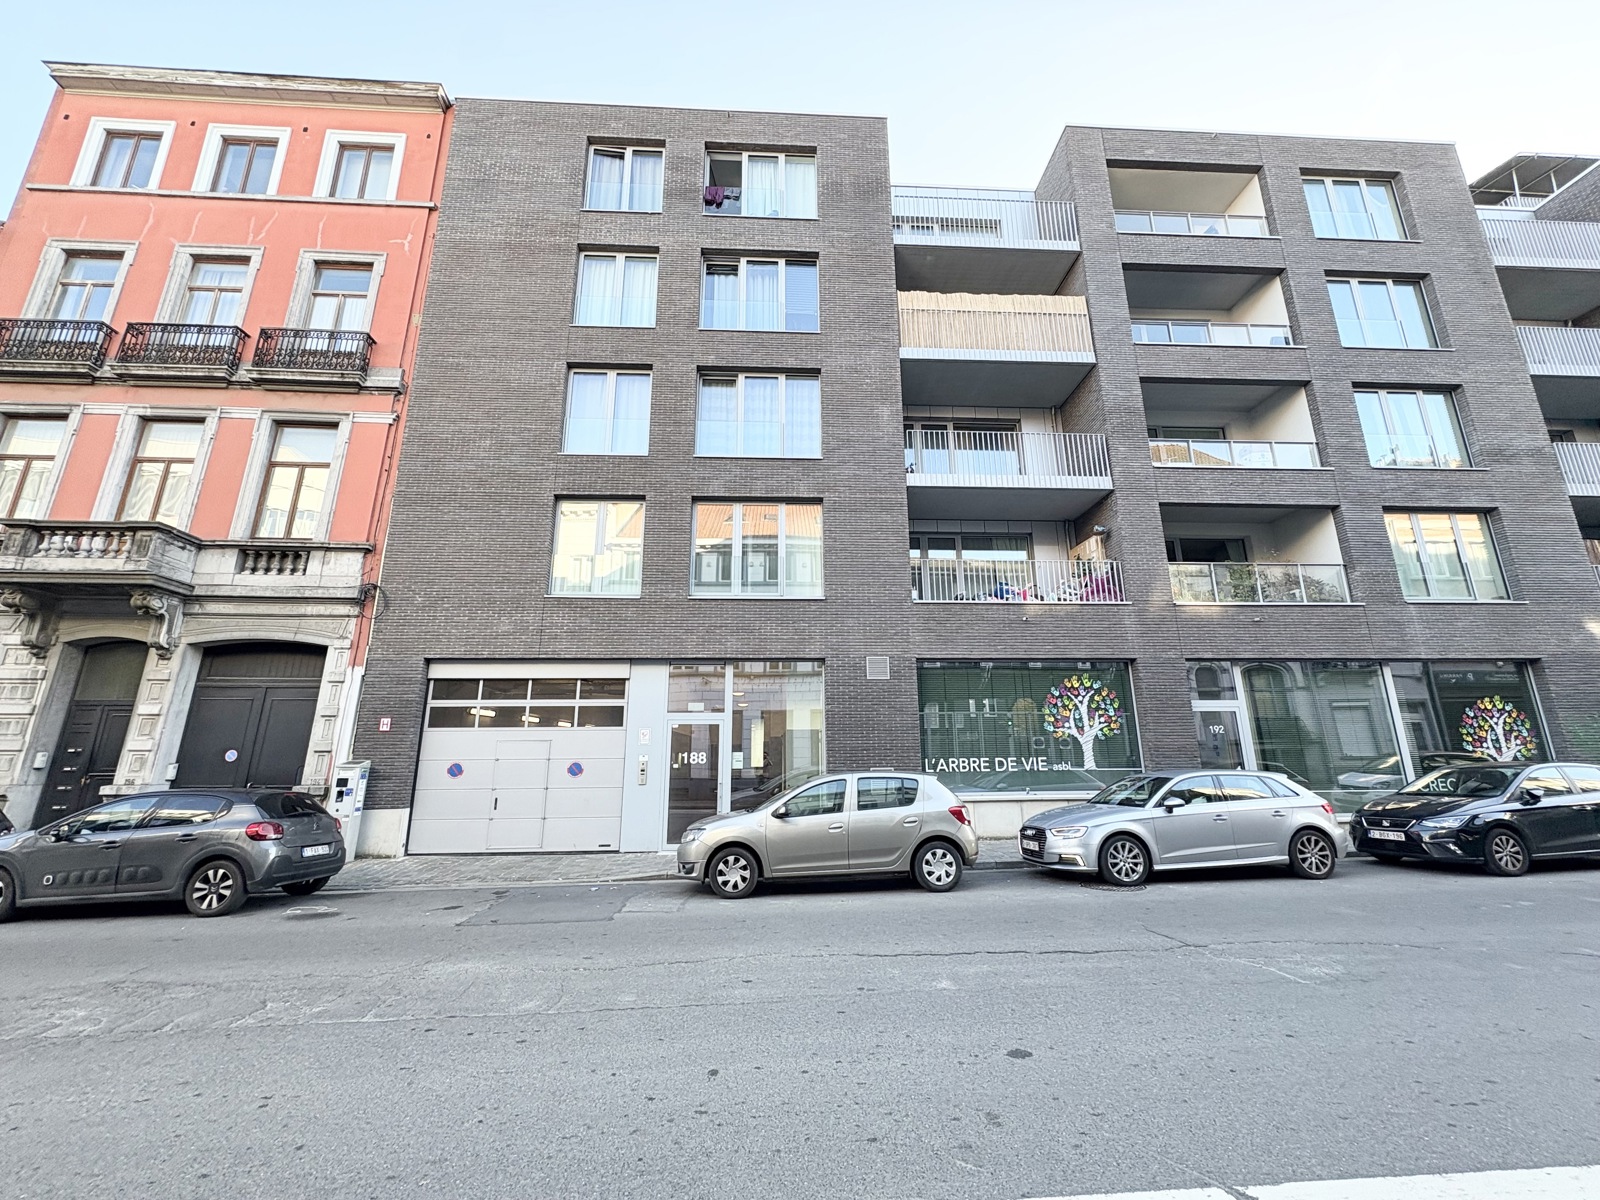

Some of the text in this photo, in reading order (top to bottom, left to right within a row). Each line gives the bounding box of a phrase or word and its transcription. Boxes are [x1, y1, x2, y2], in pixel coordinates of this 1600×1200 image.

[1209, 725, 1225, 734] 192
[682, 751, 707, 764] 188
[995, 757, 1019, 772] DE
[1021, 756, 1049, 771] VIE
[1052, 761, 1073, 771] asbl
